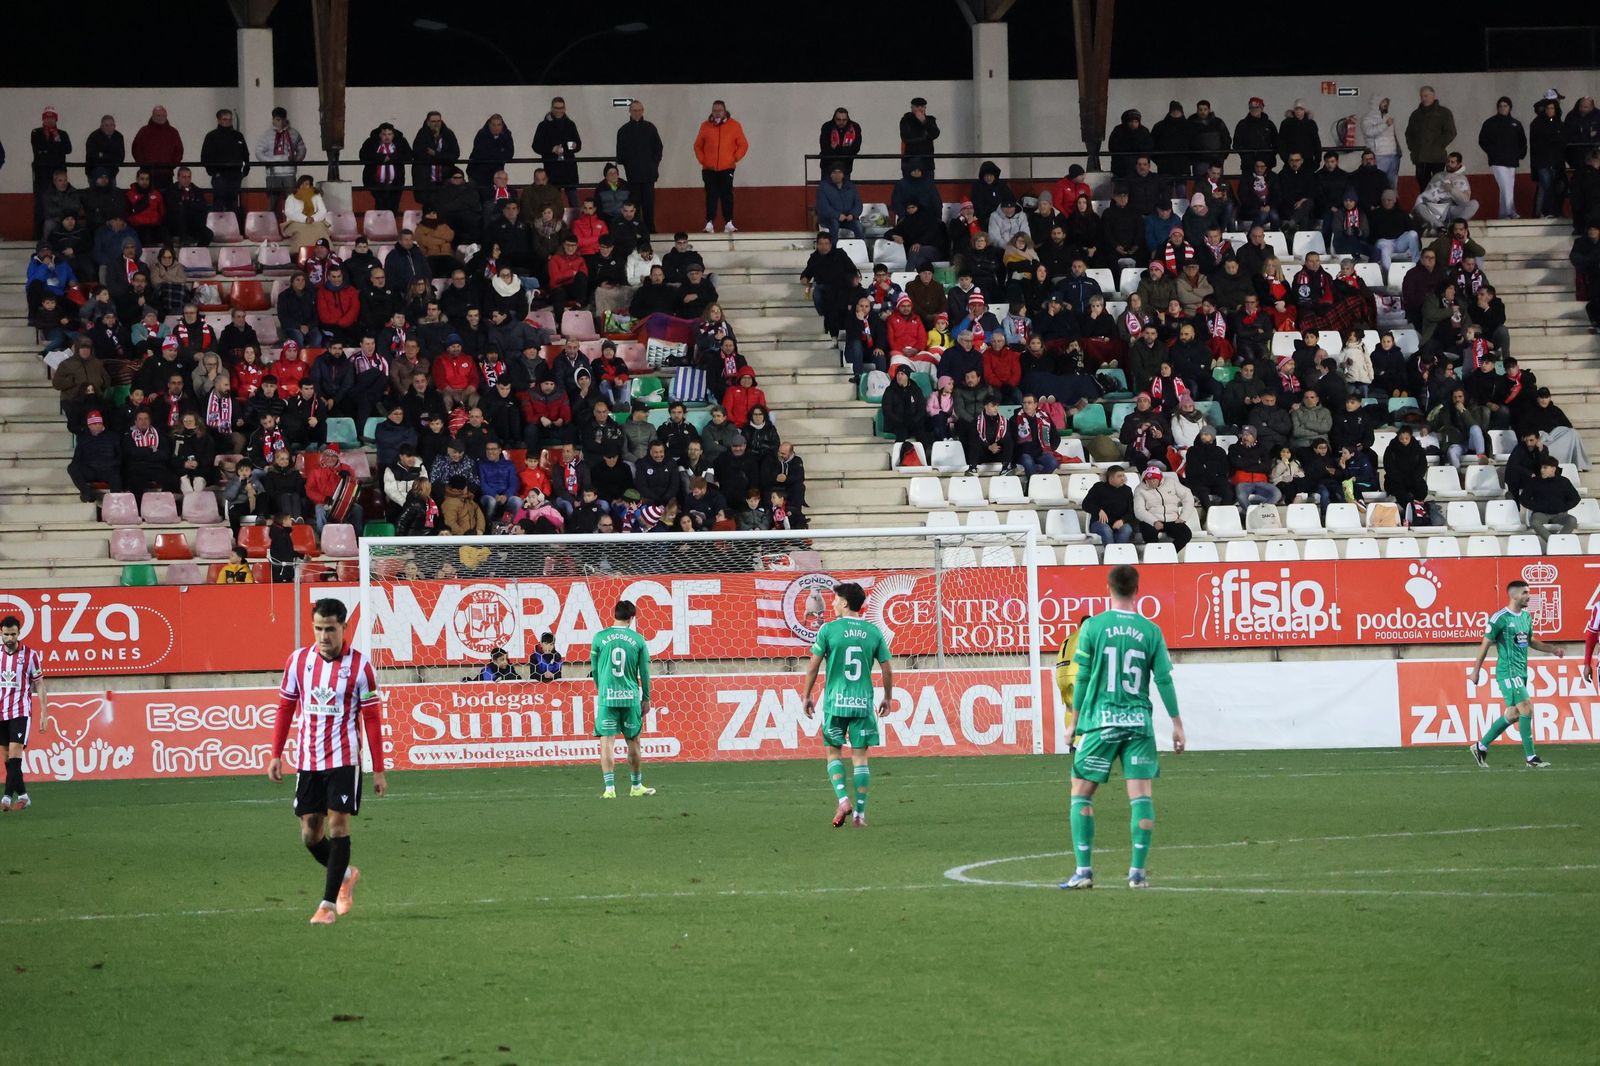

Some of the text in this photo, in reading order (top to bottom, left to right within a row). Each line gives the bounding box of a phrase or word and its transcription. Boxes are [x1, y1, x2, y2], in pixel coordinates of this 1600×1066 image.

[798, 577, 834, 588] FONDO
[1222, 568, 1325, 614] fisio
[618, 580, 721, 656] CF
[1038, 589, 1161, 620] ÓPTIO
[1224, 602, 1342, 638] readapt
[844, 629, 867, 639] JAIRO
[1105, 626, 1144, 642] ZALAYA
[1224, 632, 1307, 641] POLICLÍNICA
[1357, 606, 1491, 640] podoactiva
[1375, 628, 1485, 639] PODOLOGÍA Y BIOMECÁNIC
[602, 633, 637, 646] A.ESCOBAR
[611, 646, 627, 678] 9
[845, 647, 862, 681] 5
[1103, 646, 1146, 695] 15
[452, 691, 545, 710] bodegas
[717, 684, 1032, 750] ZAMRA CF
